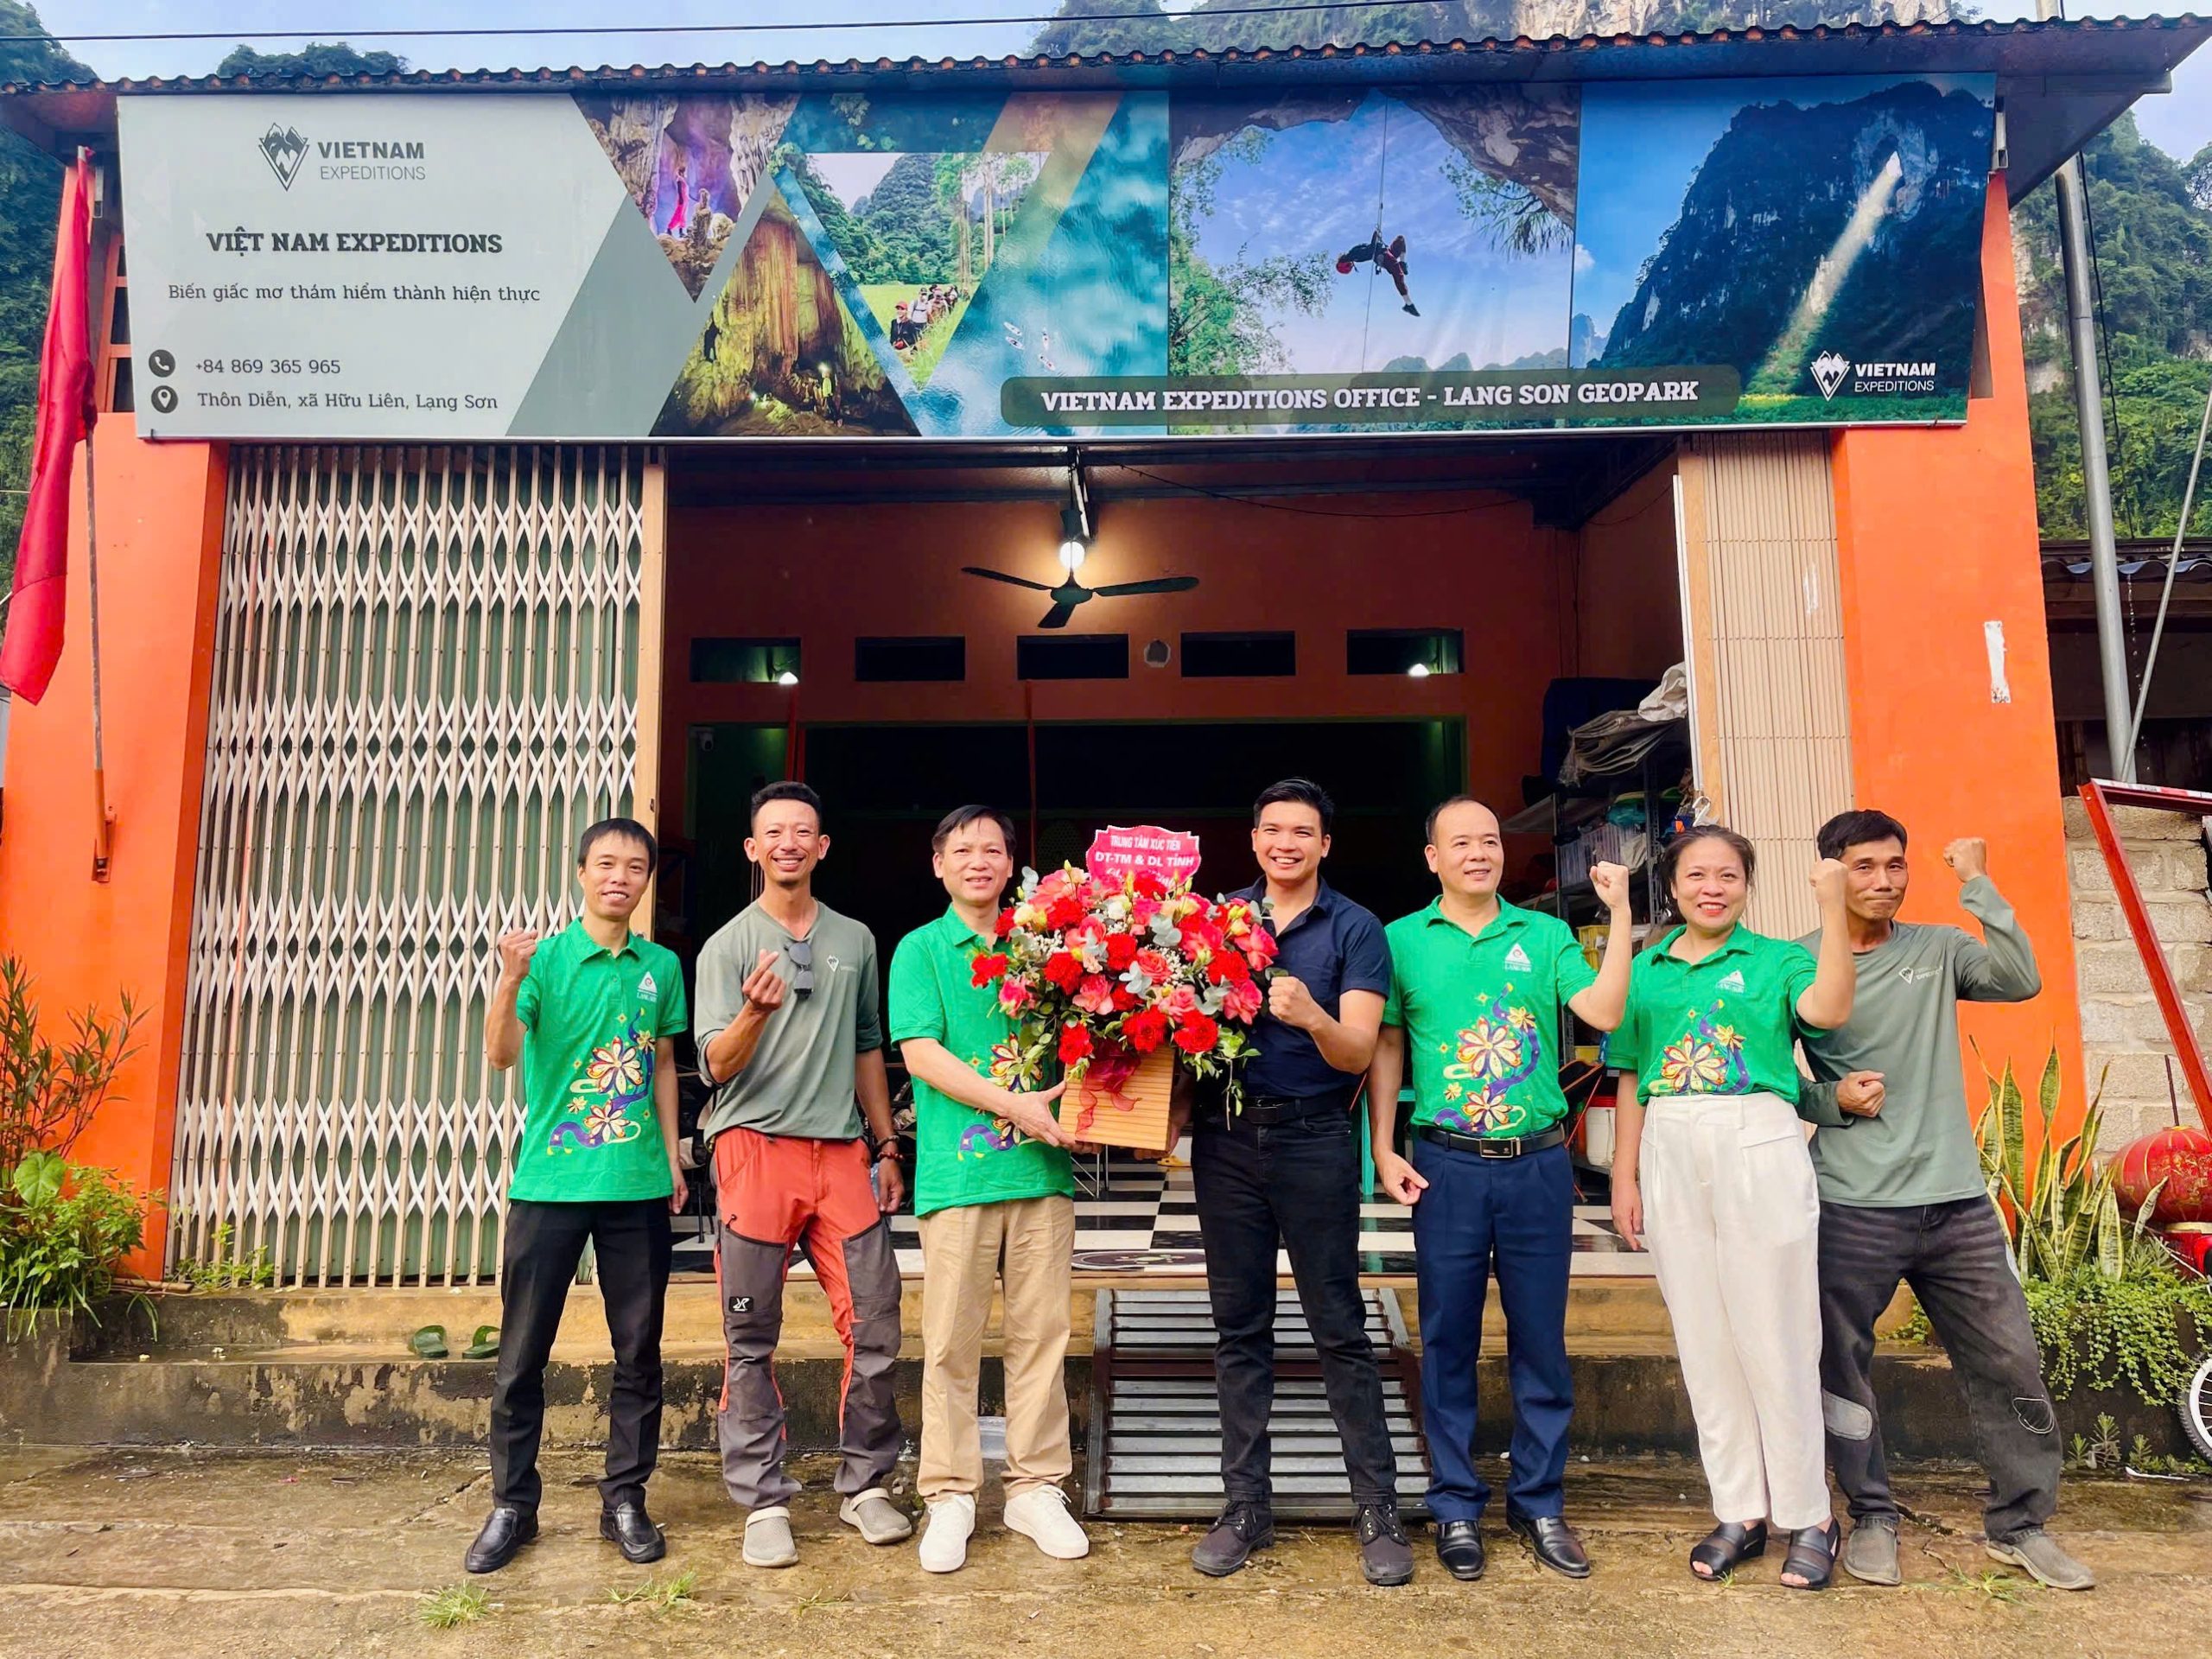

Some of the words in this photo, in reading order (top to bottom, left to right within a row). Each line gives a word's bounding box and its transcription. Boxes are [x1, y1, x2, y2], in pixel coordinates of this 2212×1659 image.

[317, 141, 425, 160] VIETNAM
[320, 165, 426, 181] EXPEDITIONS
[206, 226, 264, 257] VIỆT
[271, 232, 330, 252] NAM
[336, 232, 503, 254] EXPEDITIONS
[168, 283, 207, 299] Biến
[213, 283, 249, 302] giấc
[256, 286, 284, 299] mơ
[290, 283, 337, 300] thám
[343, 283, 387, 300] hiểm
[393, 284, 447, 301] thành
[453, 285, 492, 303] hiện
[498, 286, 541, 304] thực
[195, 359, 225, 373] +84
[231, 359, 264, 374] 869
[270, 359, 302, 374] 365
[308, 359, 341, 374] 965
[1854, 362, 1936, 378] VIETNAM
[1854, 380, 1936, 392] EXPEDITIONS
[197, 391, 242, 407] Thôn
[248, 391, 292, 410] Diễn,
[298, 392, 319, 408] xã
[324, 392, 362, 408] Hữu
[369, 393, 410, 410] Liên,
[416, 394, 458, 412] Lạng
[465, 394, 499, 410] Sơn
[1040, 391, 1156, 411] VIETNAM
[1162, 389, 1328, 410] EXPEDITIONS
[1333, 387, 1421, 409] OFFICE
[1444, 385, 1512, 406] LANG
[1519, 385, 1571, 404] SON
[1578, 381, 1699, 403] GEOPARK
[1135, 855, 1144, 865] &
[1147, 855, 1164, 867] DL
